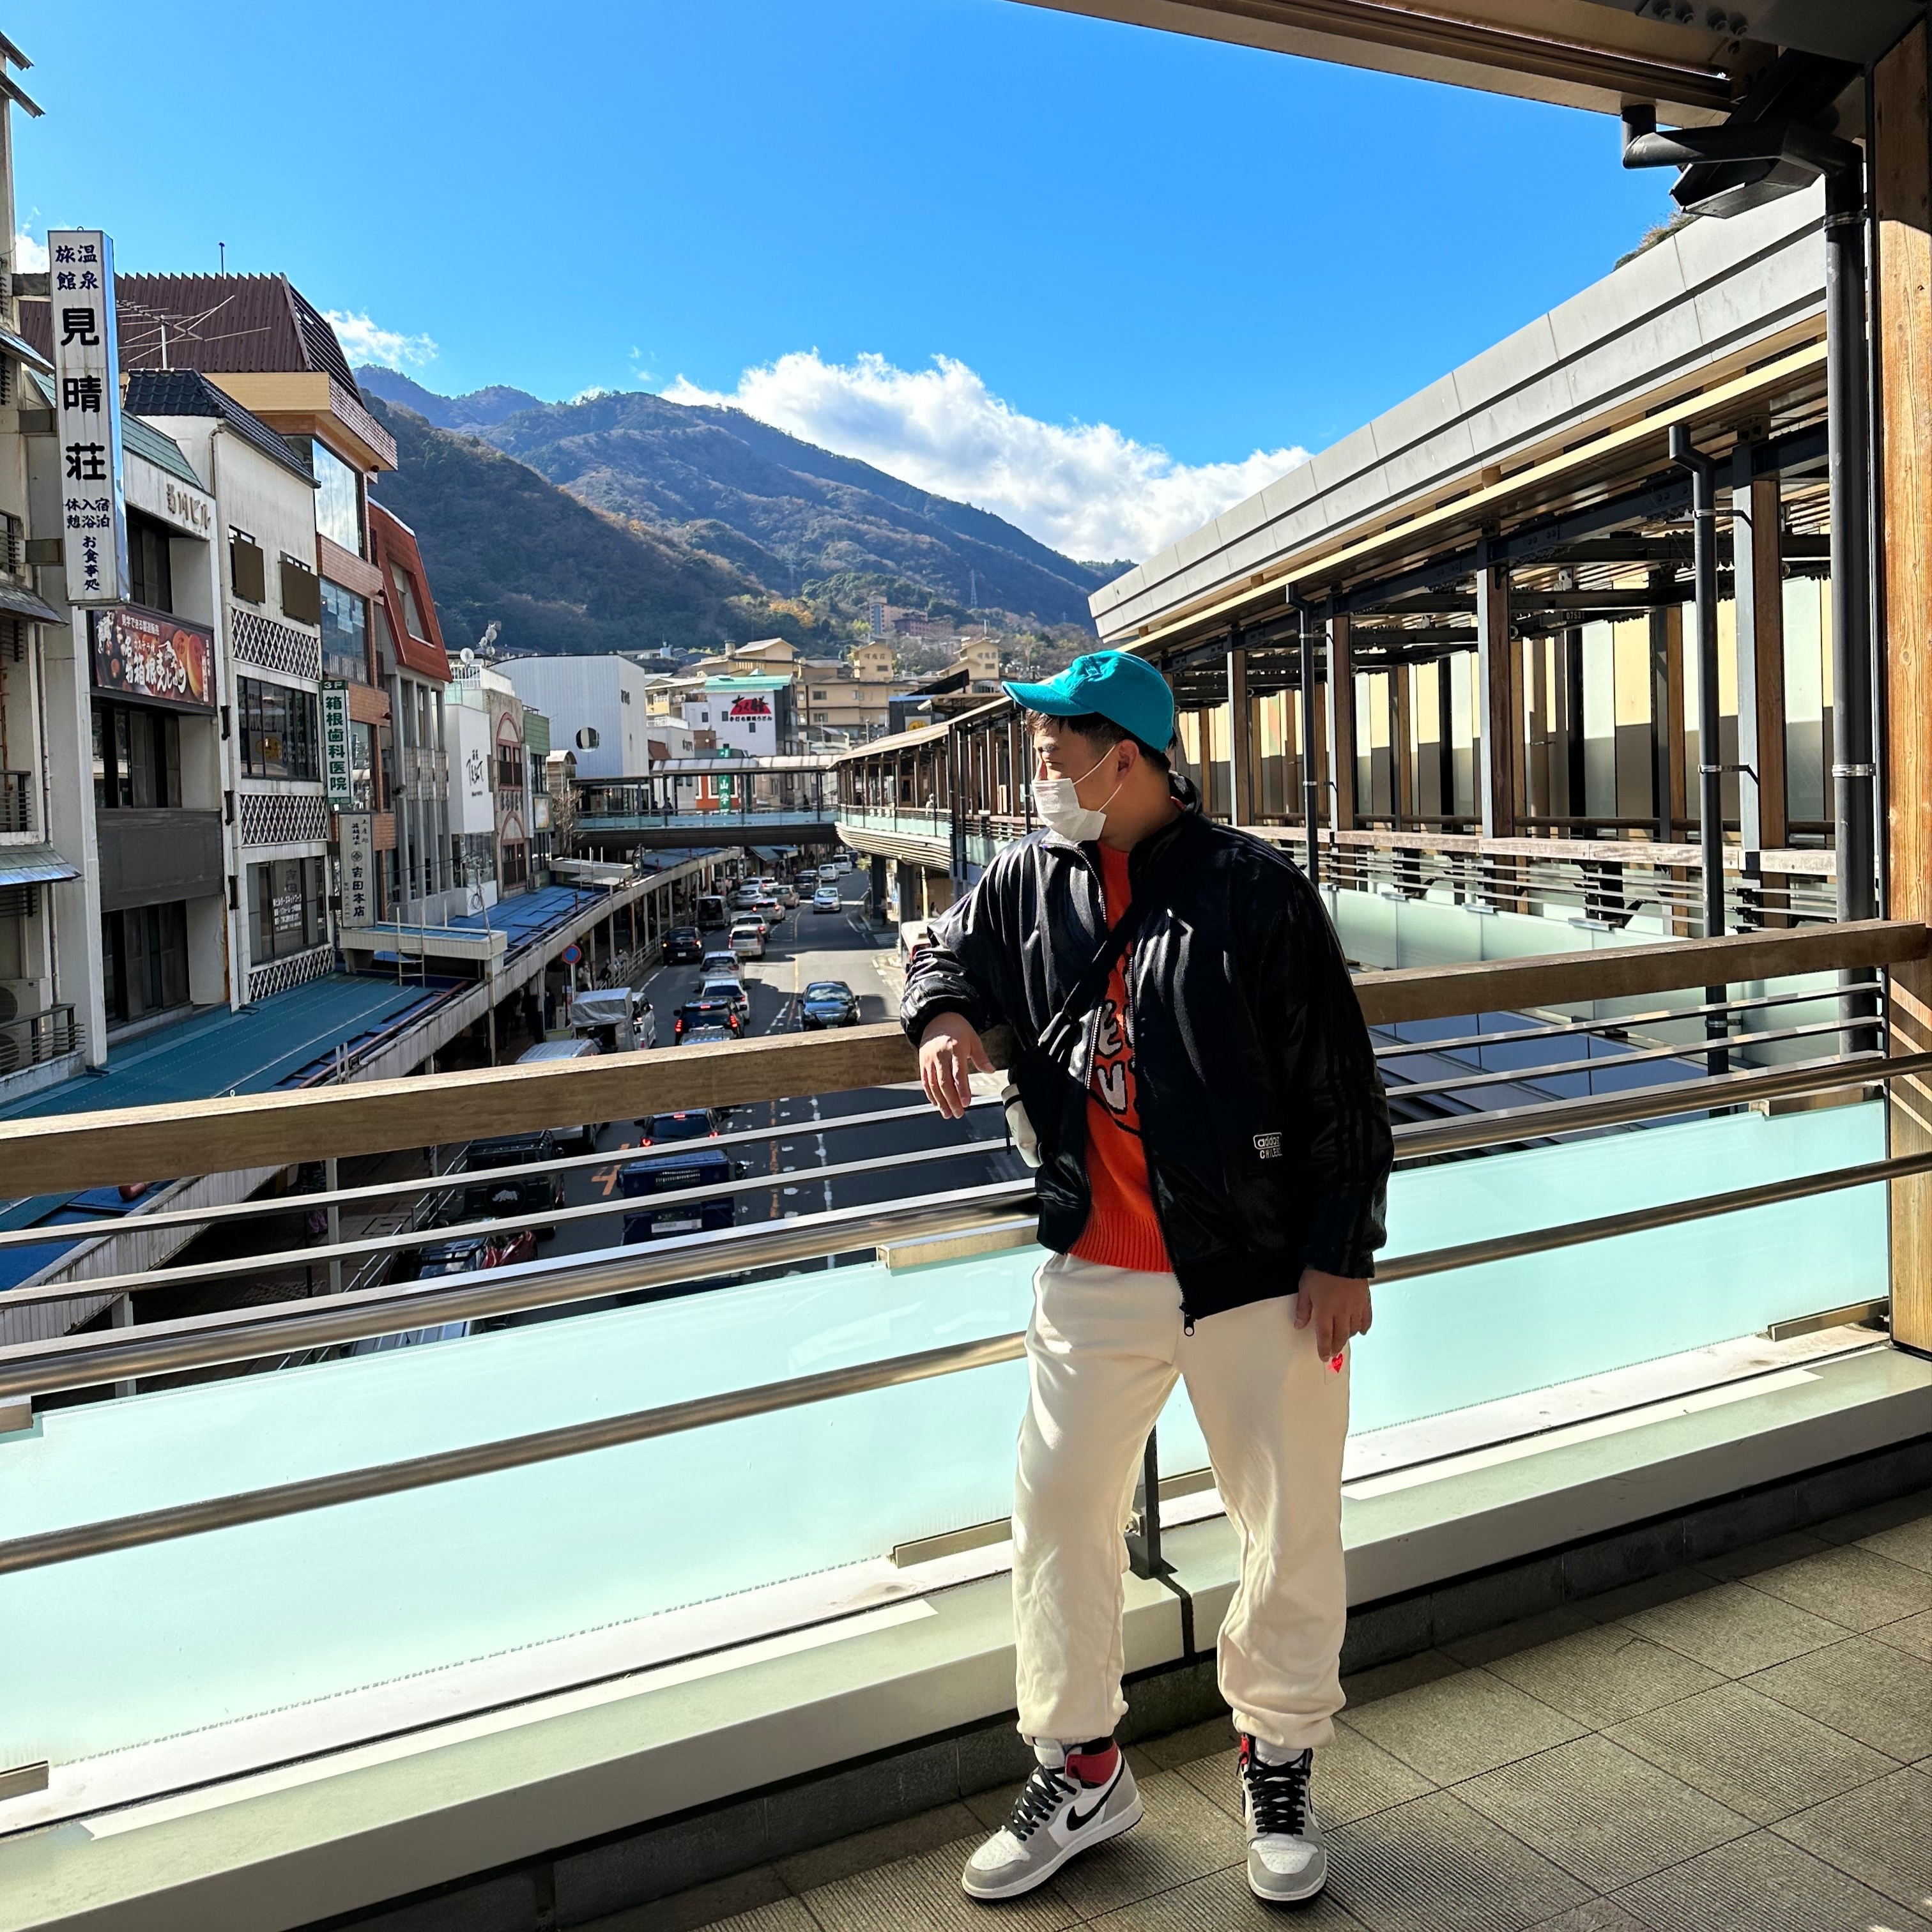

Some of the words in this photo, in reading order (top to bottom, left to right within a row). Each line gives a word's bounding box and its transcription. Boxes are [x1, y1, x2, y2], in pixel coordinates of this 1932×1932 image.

[55, 245, 77, 291] 旅館
[77, 244, 100, 290] 温泉
[61, 307, 107, 480] 見晴荘
[82, 535, 100, 591] お食事処
[325, 696, 347, 791] 箱根歯科医院
[351, 866, 366, 917] 吉田本店
